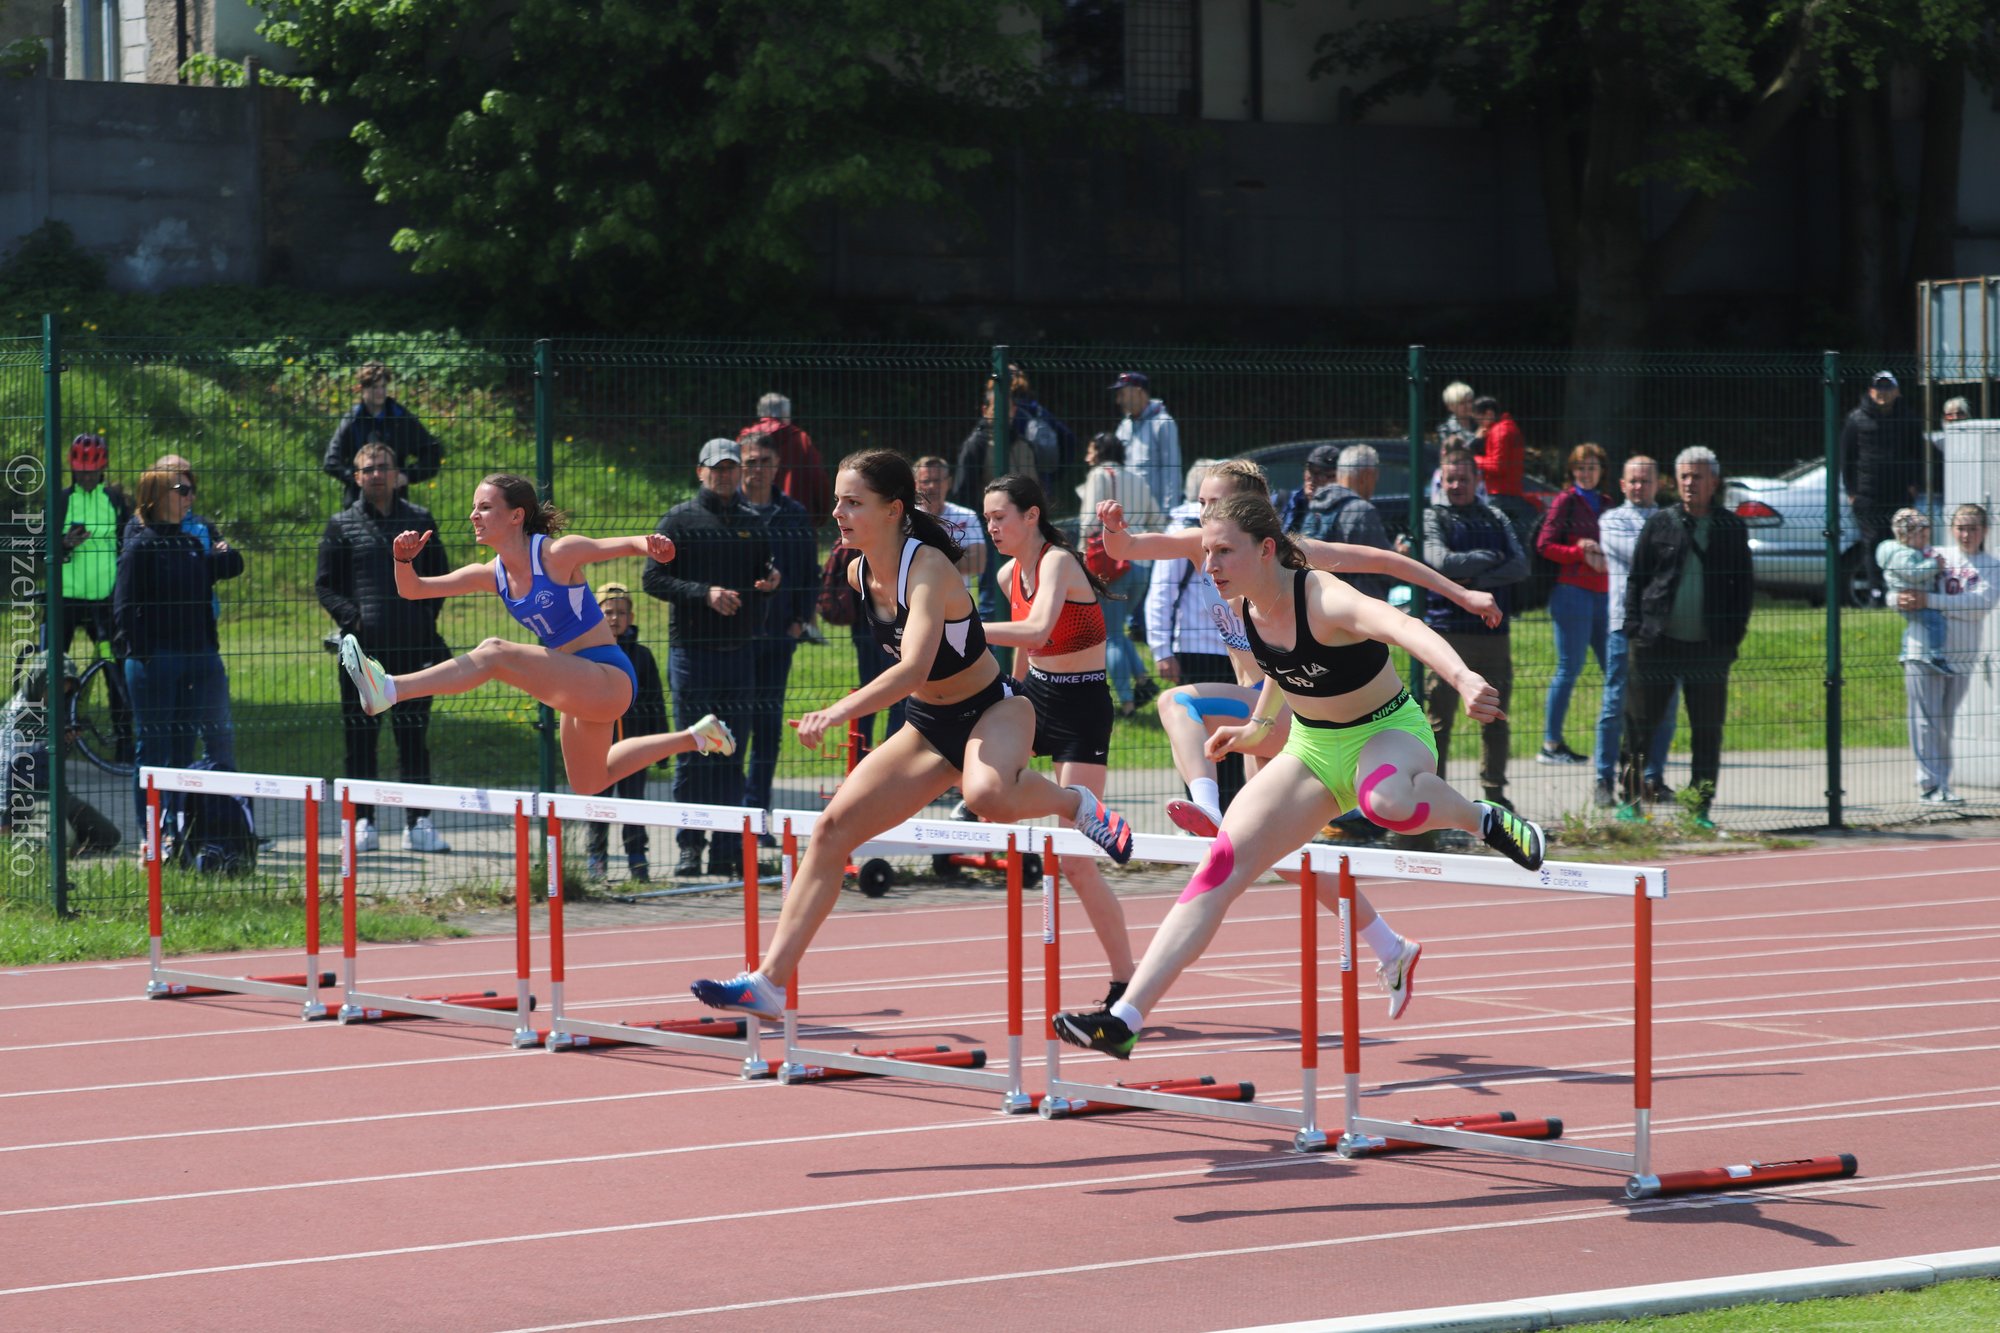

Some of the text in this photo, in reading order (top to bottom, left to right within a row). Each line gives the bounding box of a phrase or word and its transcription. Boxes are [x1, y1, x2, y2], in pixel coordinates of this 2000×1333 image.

[1050, 675, 1081, 684] NIKE
[1082, 672, 1106, 683] PRO
[1372, 699, 1399, 722] NIKE
